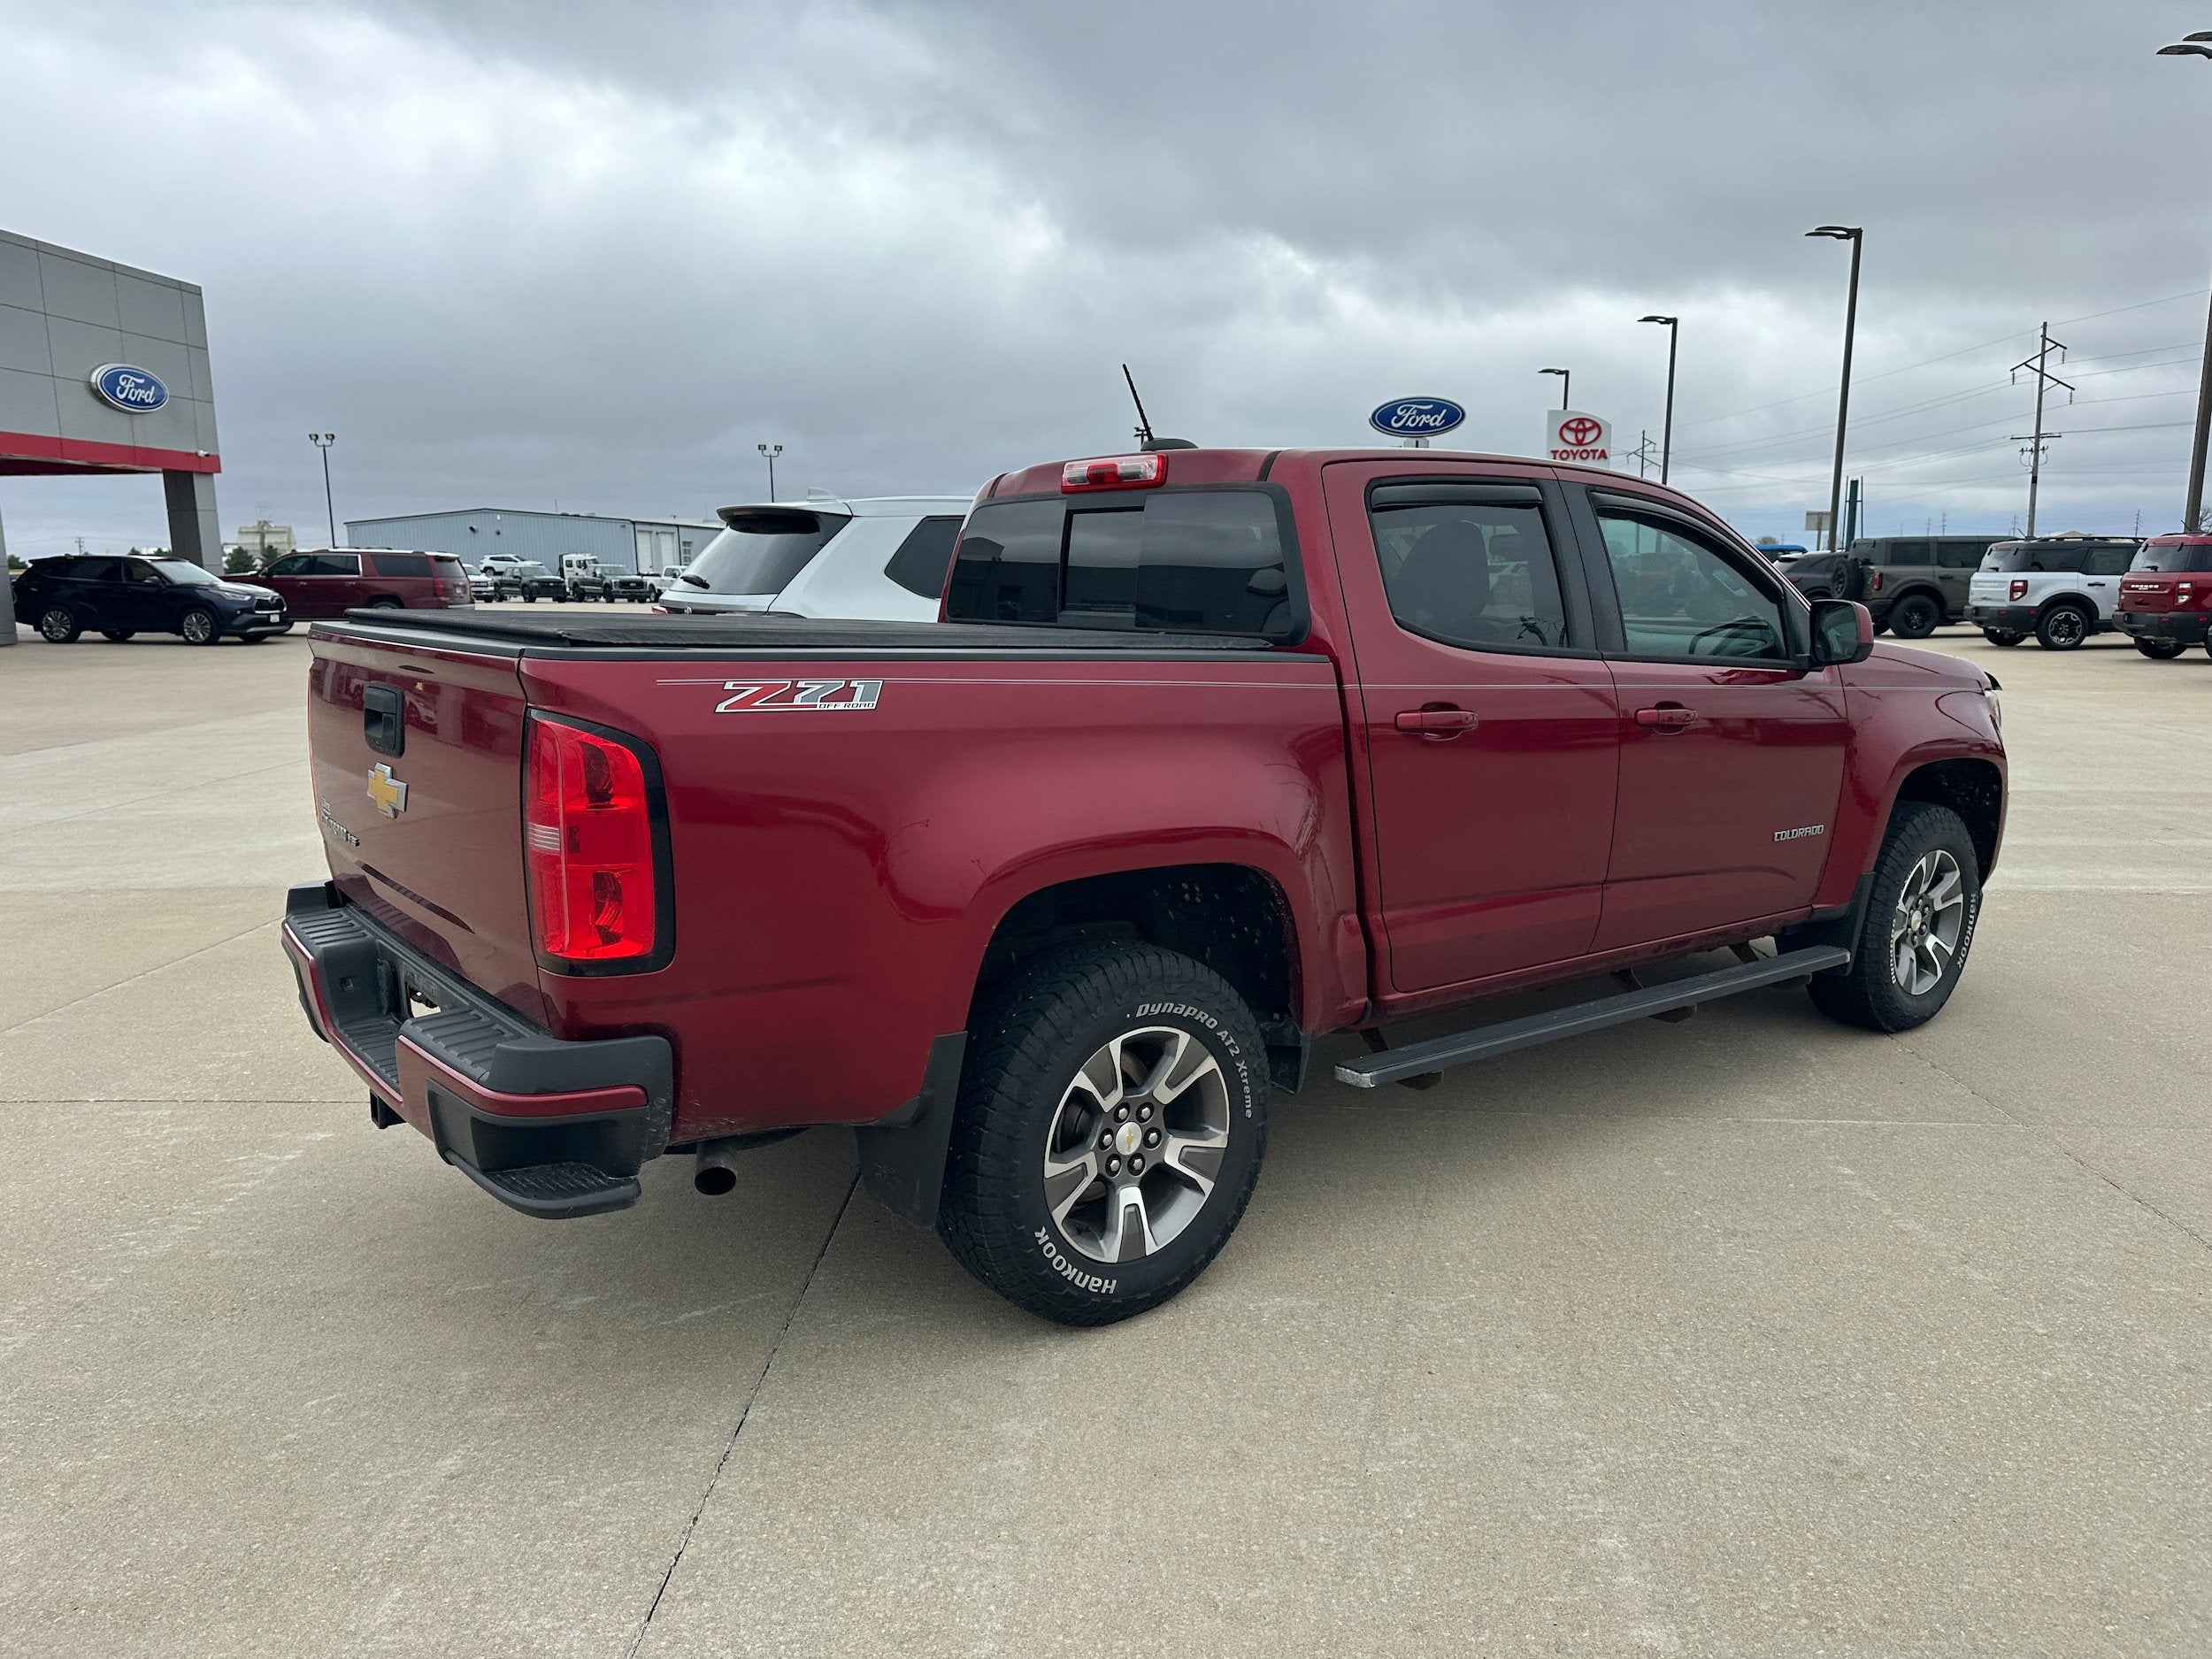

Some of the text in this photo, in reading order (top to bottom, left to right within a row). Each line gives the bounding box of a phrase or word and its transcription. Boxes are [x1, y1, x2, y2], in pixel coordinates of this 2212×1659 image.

[116, 373, 156, 403] Ford
[1390, 403, 1446, 428] Ford
[1550, 449, 1608, 460] TOYOTA
[715, 680, 883, 712] Z71
[1773, 825, 1824, 841] COLORADO
[1216, 1030, 1240, 1056] AT2
[1234, 1060, 1252, 1118] Xtreme
